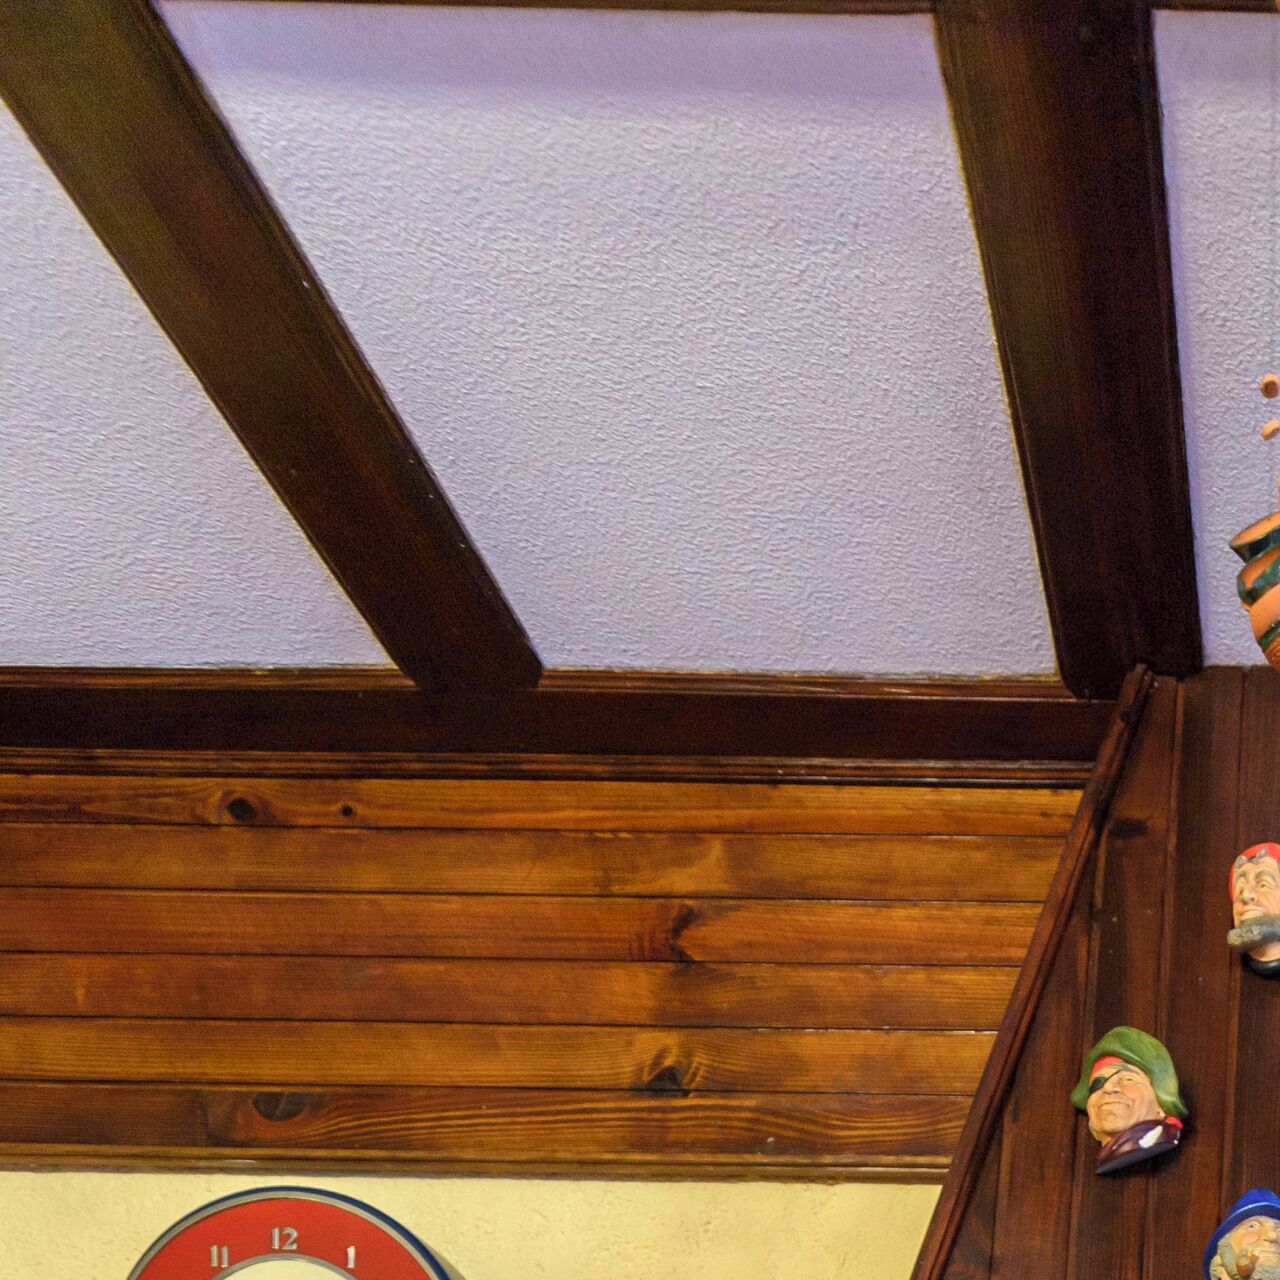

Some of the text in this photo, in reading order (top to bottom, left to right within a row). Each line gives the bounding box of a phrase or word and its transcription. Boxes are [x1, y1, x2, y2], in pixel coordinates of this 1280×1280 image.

[271, 1226, 299, 1250] 12
[210, 1244, 230, 1268] 11
[347, 1246, 356, 1269] 1
